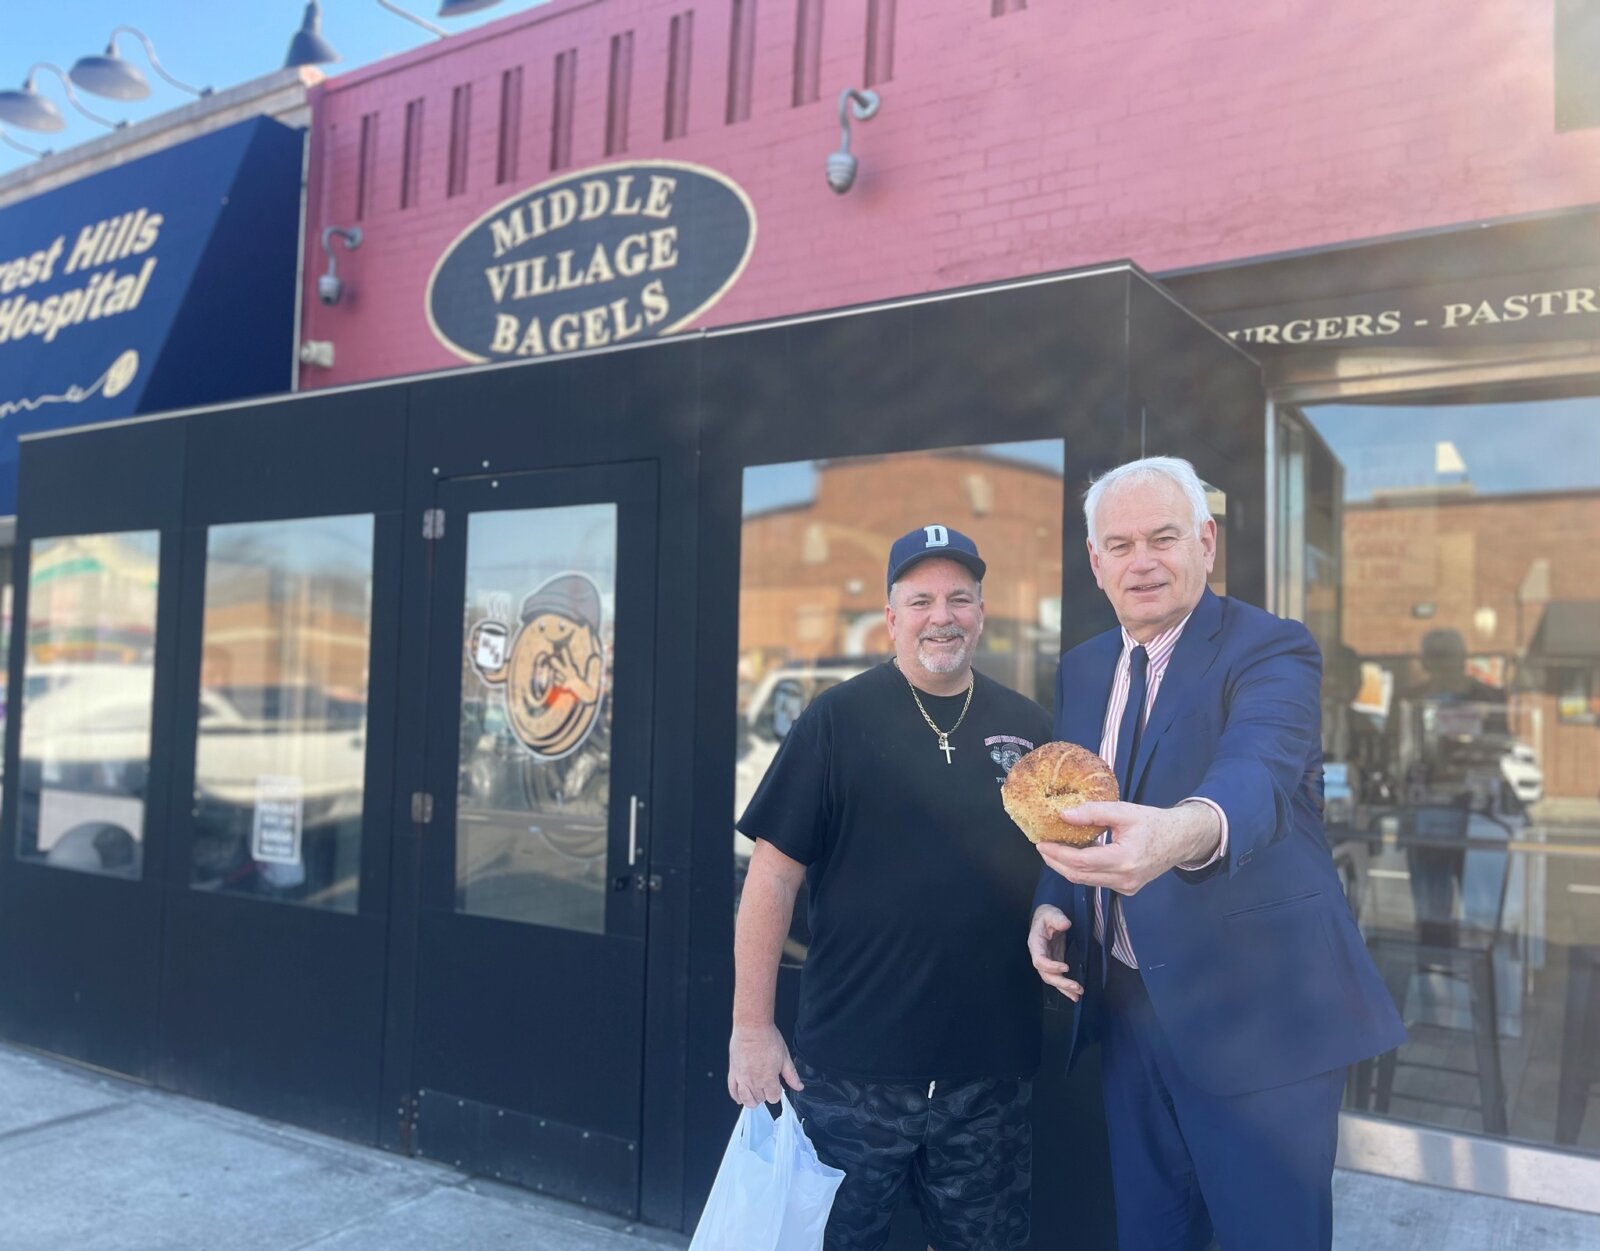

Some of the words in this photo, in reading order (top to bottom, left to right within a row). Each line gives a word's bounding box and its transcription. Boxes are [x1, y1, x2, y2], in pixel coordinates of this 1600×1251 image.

[64, 207, 164, 275] Hills
[489, 174, 677, 258] MIDDLE
[0, 256, 157, 343] Hospital
[485, 225, 679, 303] VILLAGE
[489, 278, 670, 356] BAGELS
[924, 525, 949, 548] D
